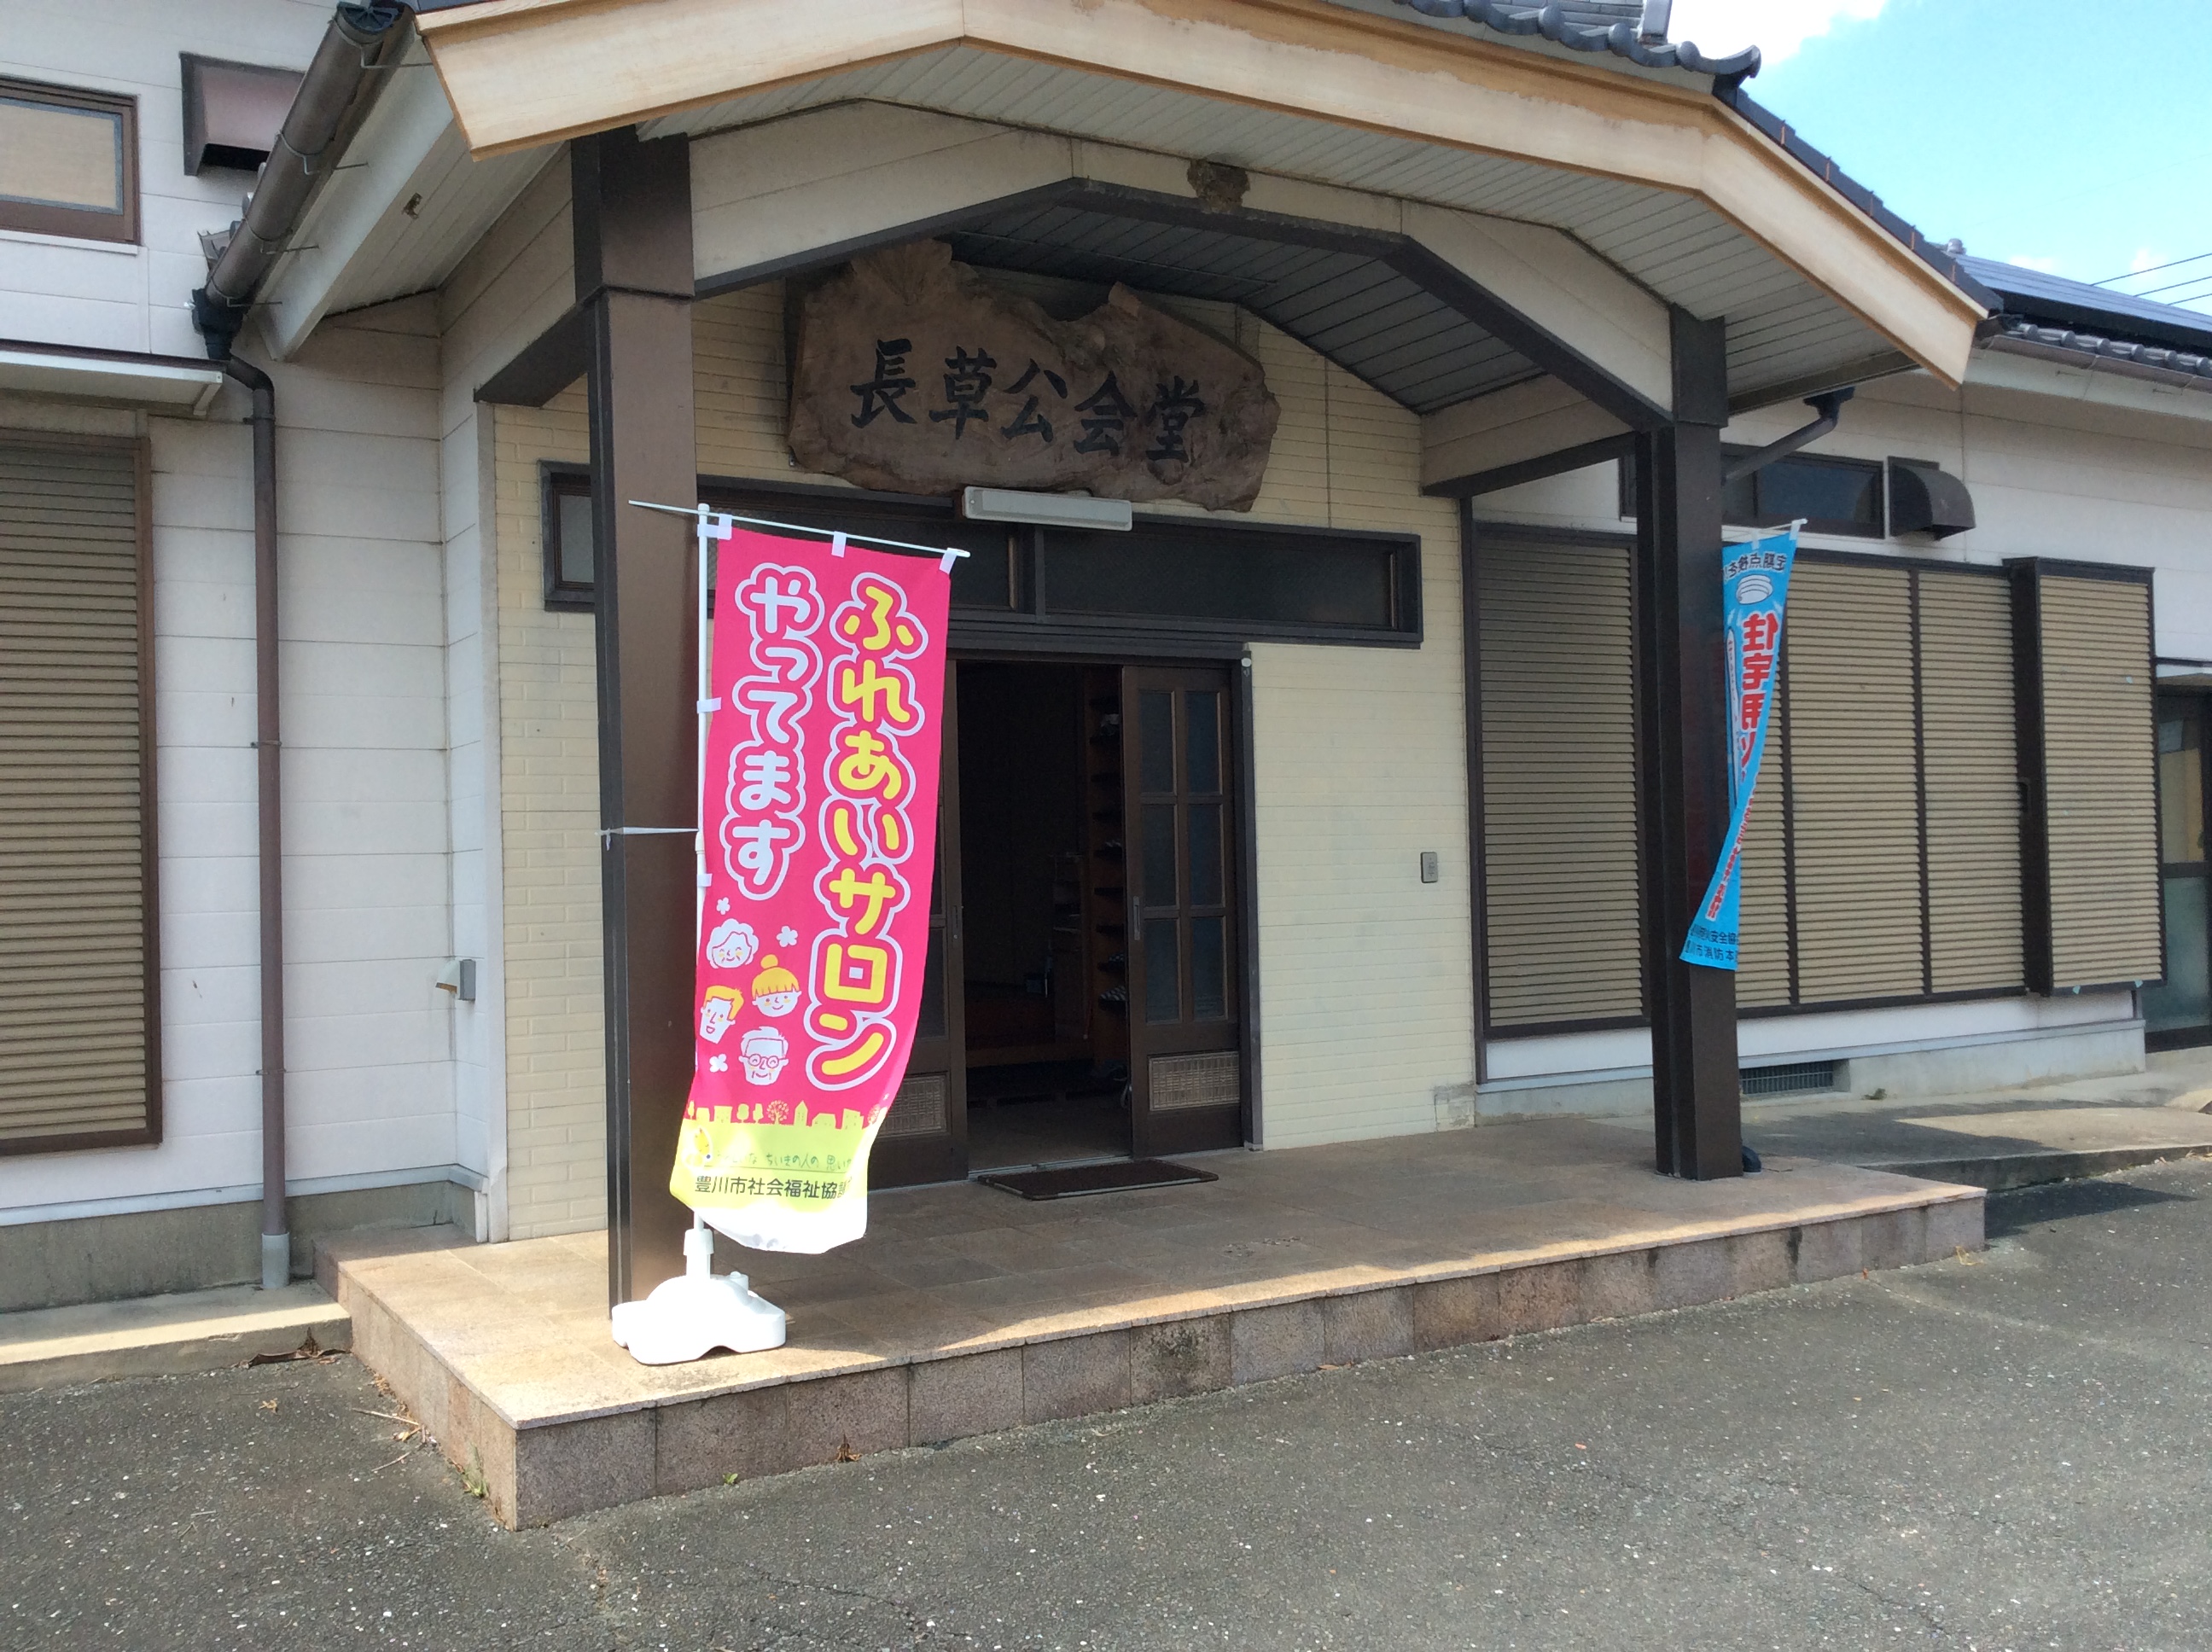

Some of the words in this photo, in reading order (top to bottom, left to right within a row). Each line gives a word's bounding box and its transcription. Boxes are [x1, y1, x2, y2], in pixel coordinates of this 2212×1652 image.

[849, 338, 1206, 463] 長草公会堂
[731, 576, 816, 887] やってます
[816, 583, 917, 1079] ふれあいサロン
